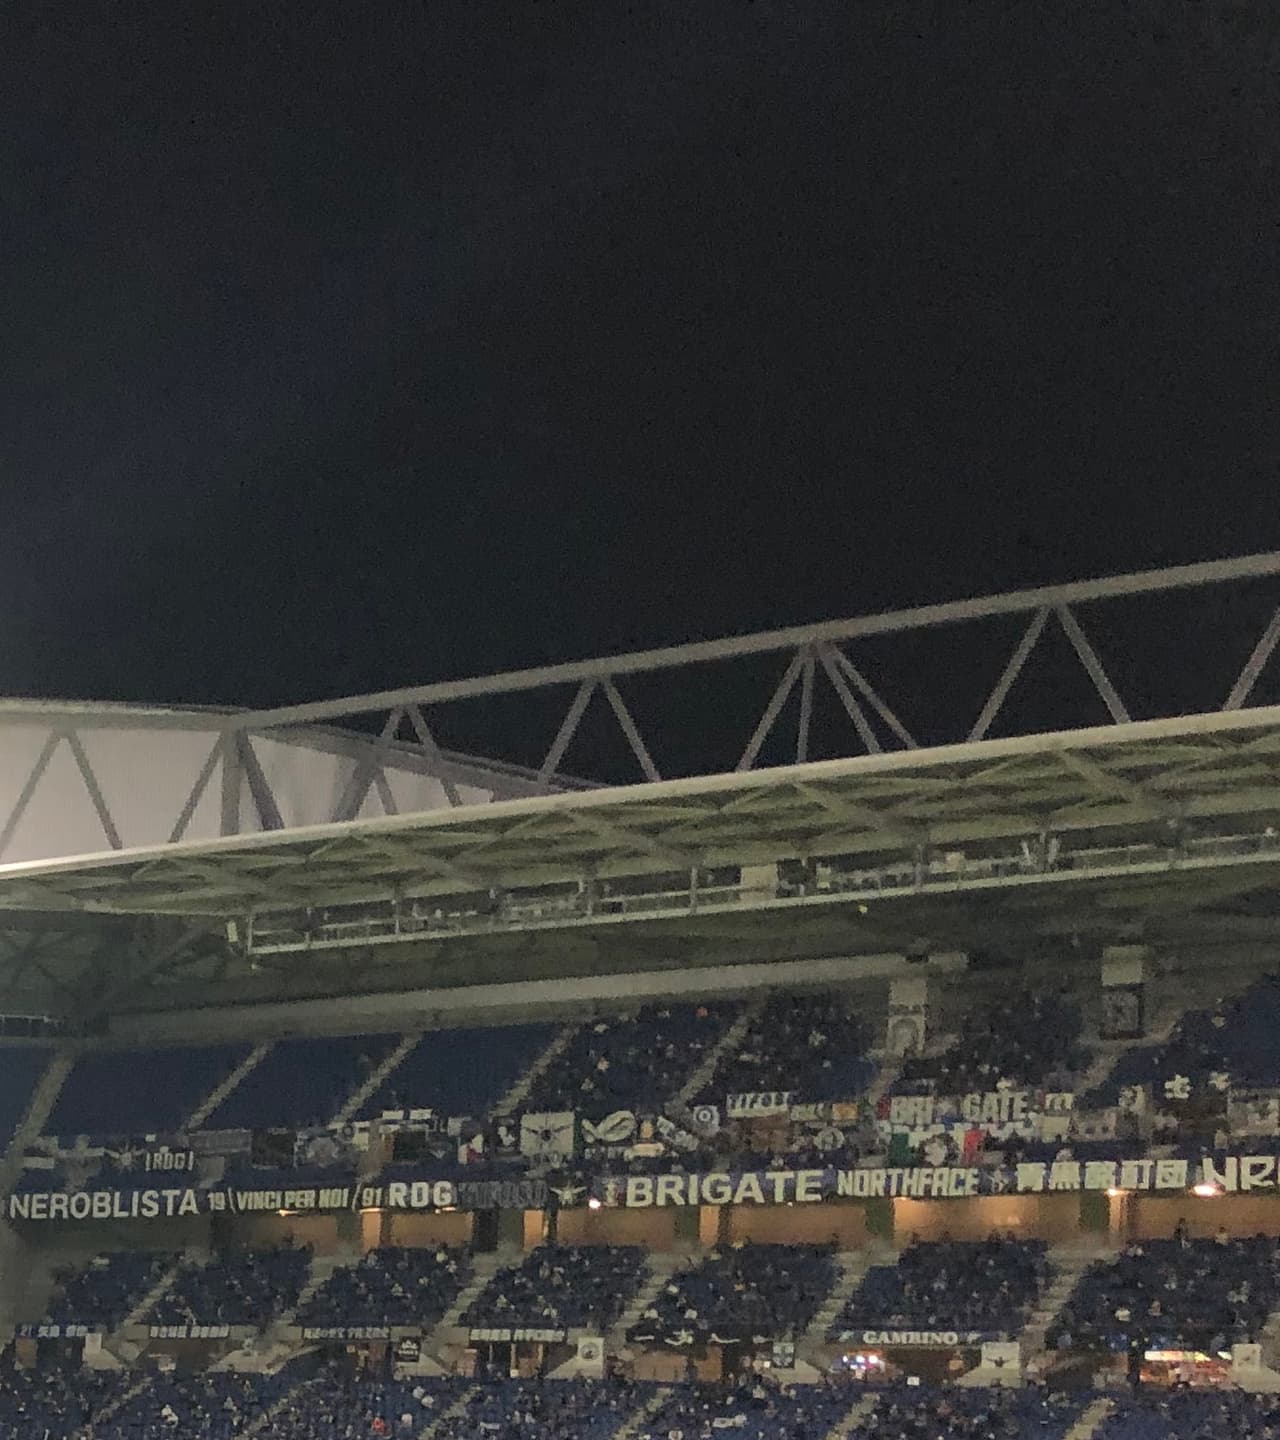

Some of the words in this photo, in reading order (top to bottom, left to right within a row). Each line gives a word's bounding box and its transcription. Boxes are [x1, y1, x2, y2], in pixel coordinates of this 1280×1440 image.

[389, 1181, 452, 1207] RDG
[625, 1170, 824, 1207] BRIGATE
[836, 1167, 978, 1197] NORTHFACE
[9, 1189, 199, 1220] NEROBLISTA
